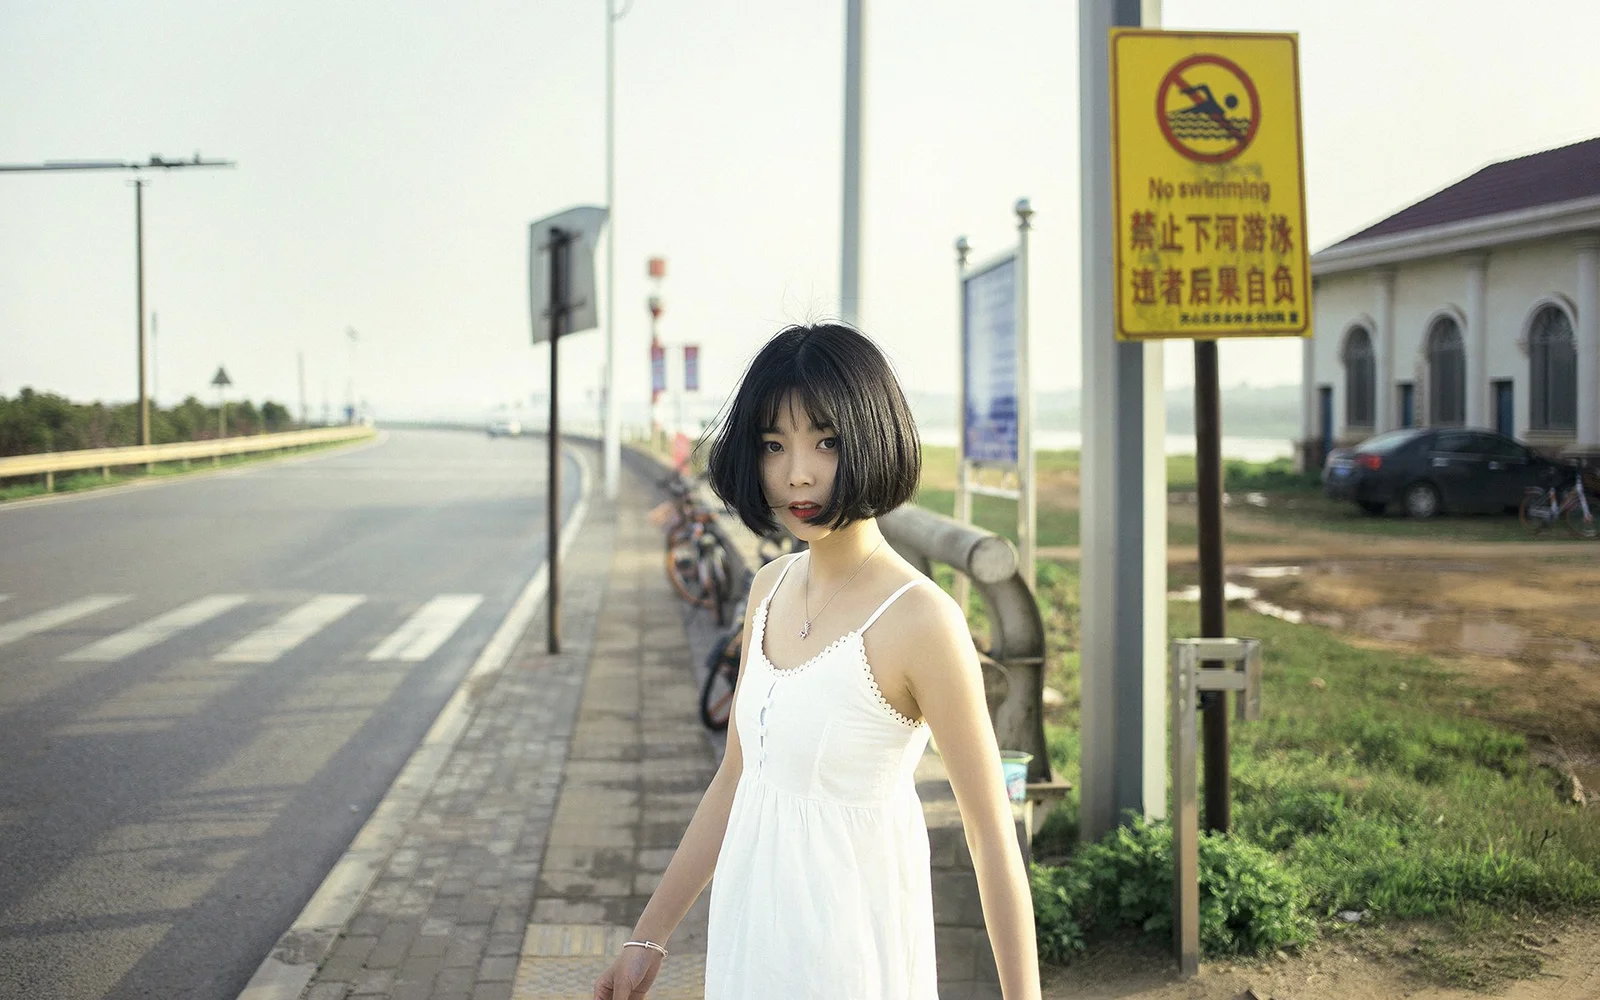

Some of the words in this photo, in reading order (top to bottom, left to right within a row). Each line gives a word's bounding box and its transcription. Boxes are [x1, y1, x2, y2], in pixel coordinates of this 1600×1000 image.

[1149, 177, 1174, 200] No
[1179, 178, 1271, 202] swimming
[1130, 209, 1294, 253] 禁止下河游泳
[1131, 265, 1295, 306] 违者后果自负
